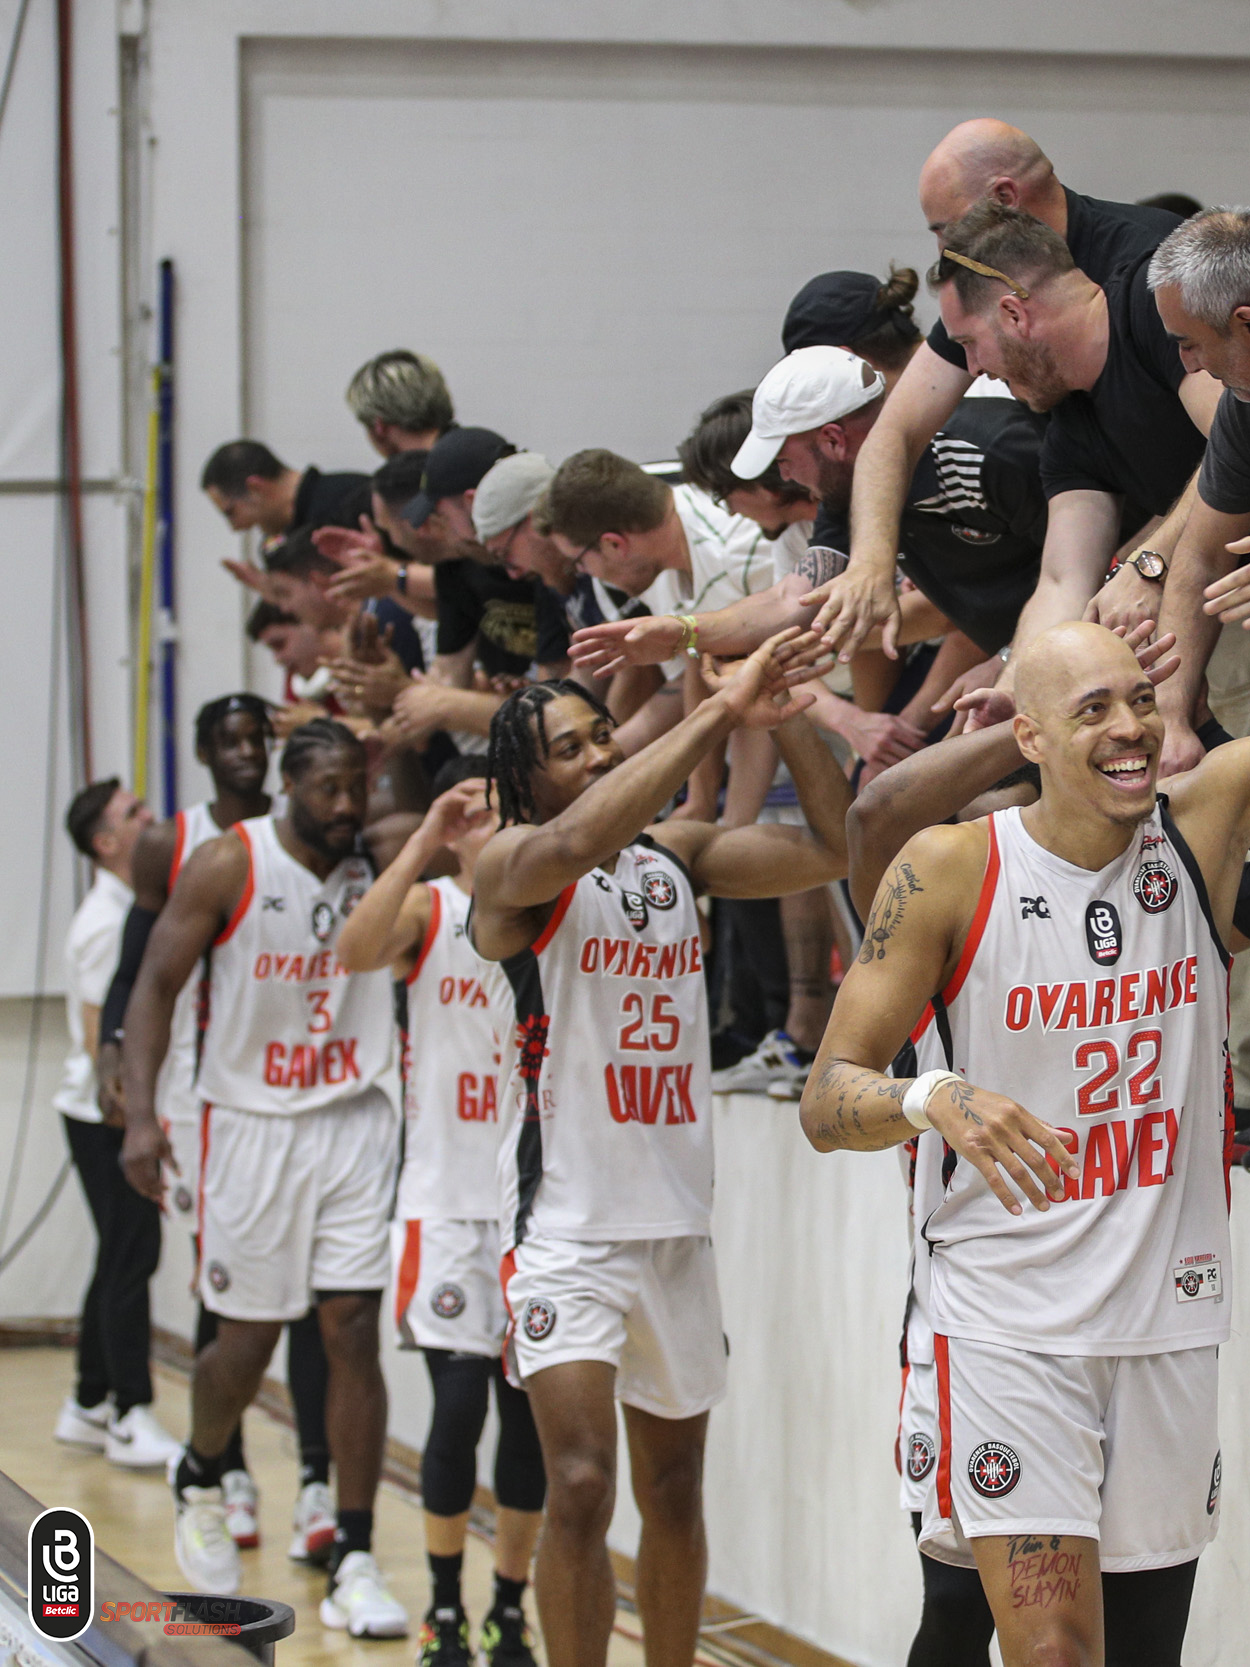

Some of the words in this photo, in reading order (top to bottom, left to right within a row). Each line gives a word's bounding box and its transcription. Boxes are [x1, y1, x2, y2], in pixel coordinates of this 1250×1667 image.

[307, 989, 331, 1033] 3
[1005, 956, 1197, 1035] OVARENSE
[619, 992, 680, 1051] 25
[1073, 1026, 1163, 1118] 22
[969, 1445, 986, 1473] OVARENSE
[987, 1443, 1020, 1471] BASQUETEBOL
[1007, 1552, 1083, 1588] DEMON
